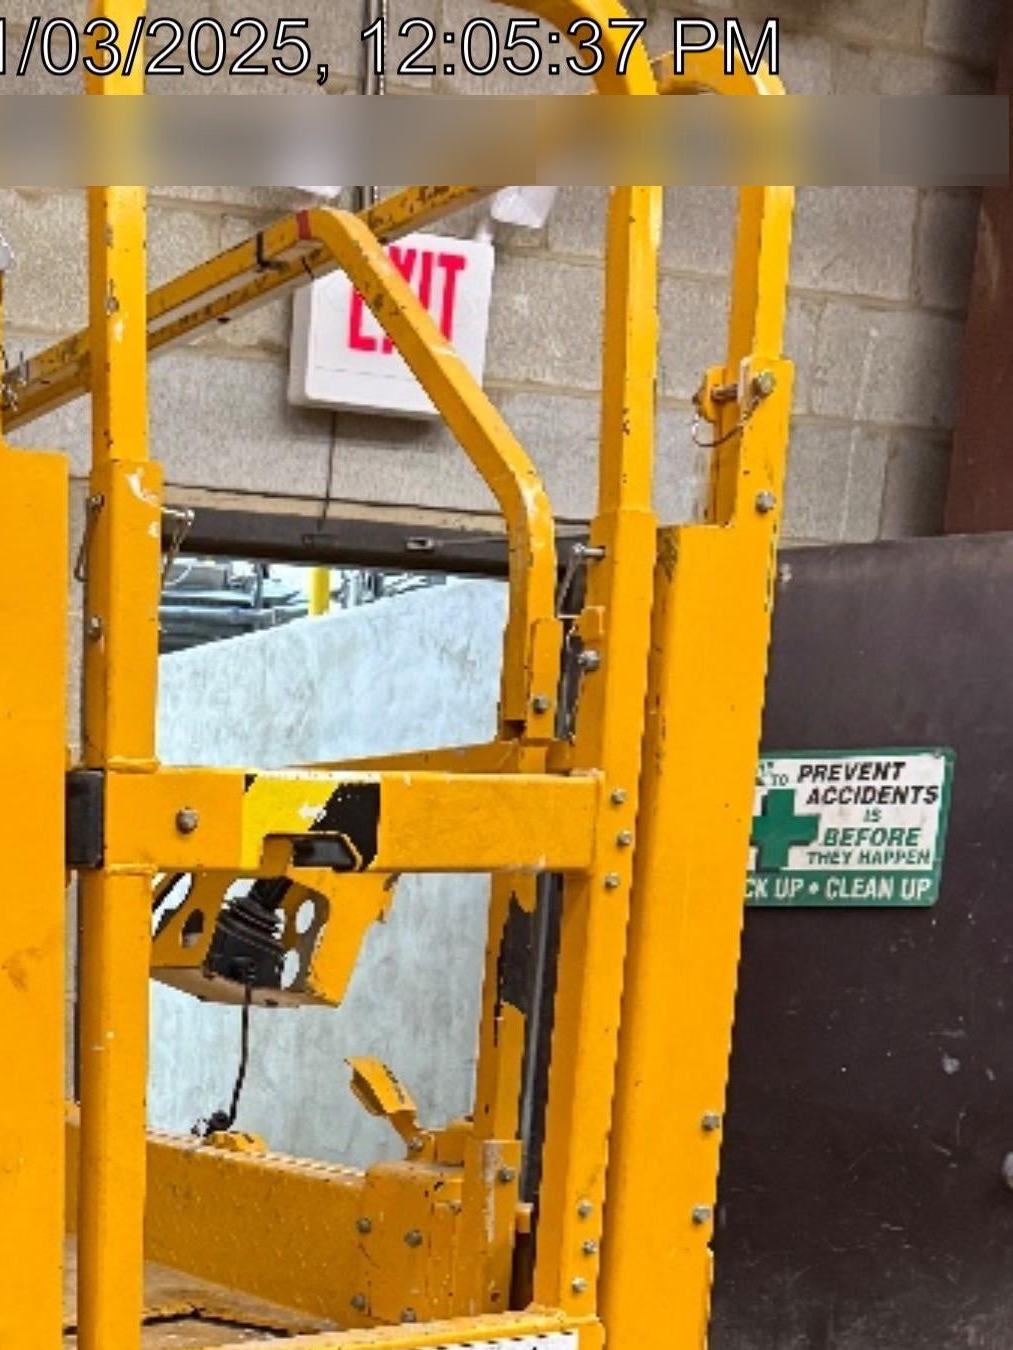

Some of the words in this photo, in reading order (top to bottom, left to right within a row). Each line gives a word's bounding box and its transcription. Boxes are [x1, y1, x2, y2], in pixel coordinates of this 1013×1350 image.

[797, 761, 906, 783] PREVENT
[806, 785, 939, 805] ACCIDENTS
[863, 807, 882, 822] IS
[823, 827, 921, 847] BEFORE
[807, 851, 855, 865] THEY
[858, 849, 931, 865] HAPPEN
[774, 878, 804, 898] UP
[826, 877, 893, 900] CLEAN
[901, 879, 932, 900] UP
